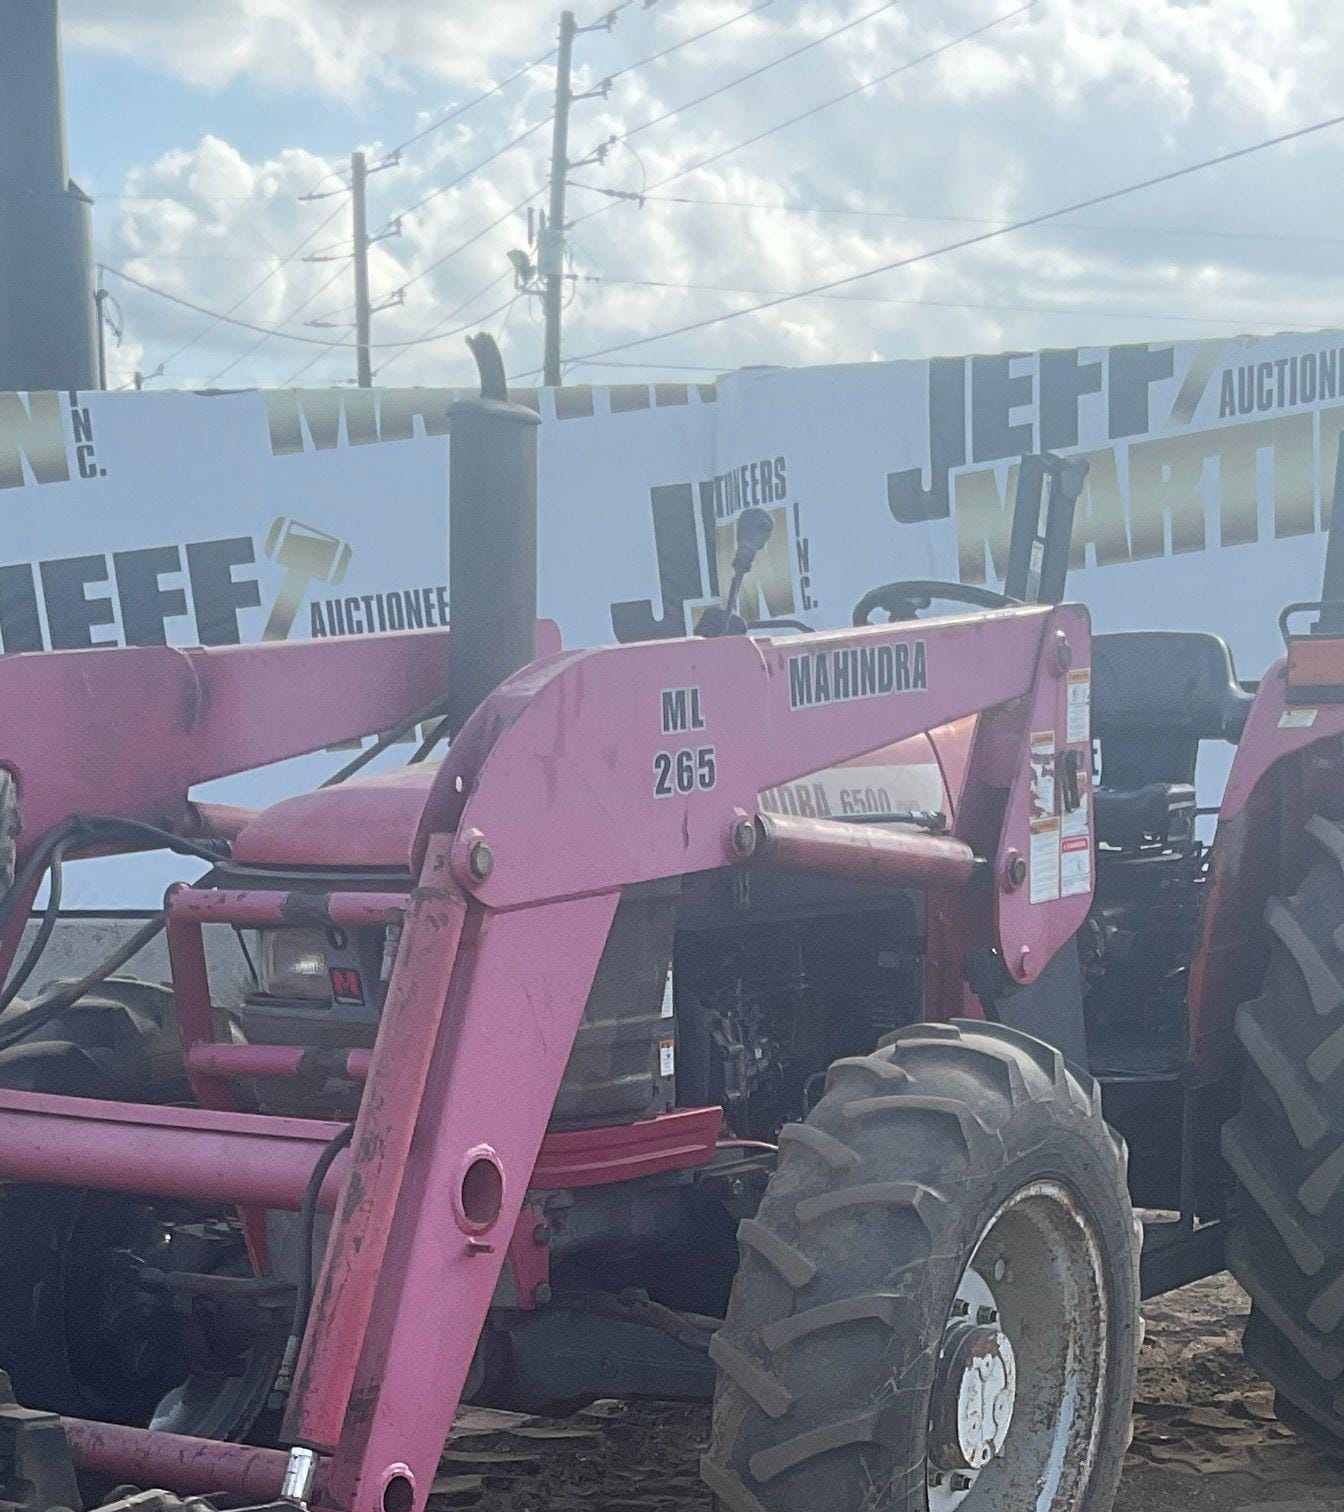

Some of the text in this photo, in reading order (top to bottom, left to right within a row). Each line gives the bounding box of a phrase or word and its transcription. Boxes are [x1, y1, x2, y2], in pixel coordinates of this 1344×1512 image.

[310, 586, 450, 638] AUCTIONEE
[788, 640, 928, 711] MAHINDRA
[661, 686, 705, 733] ML
[654, 748, 716, 798] 265
[839, 787, 892, 815] 6500
